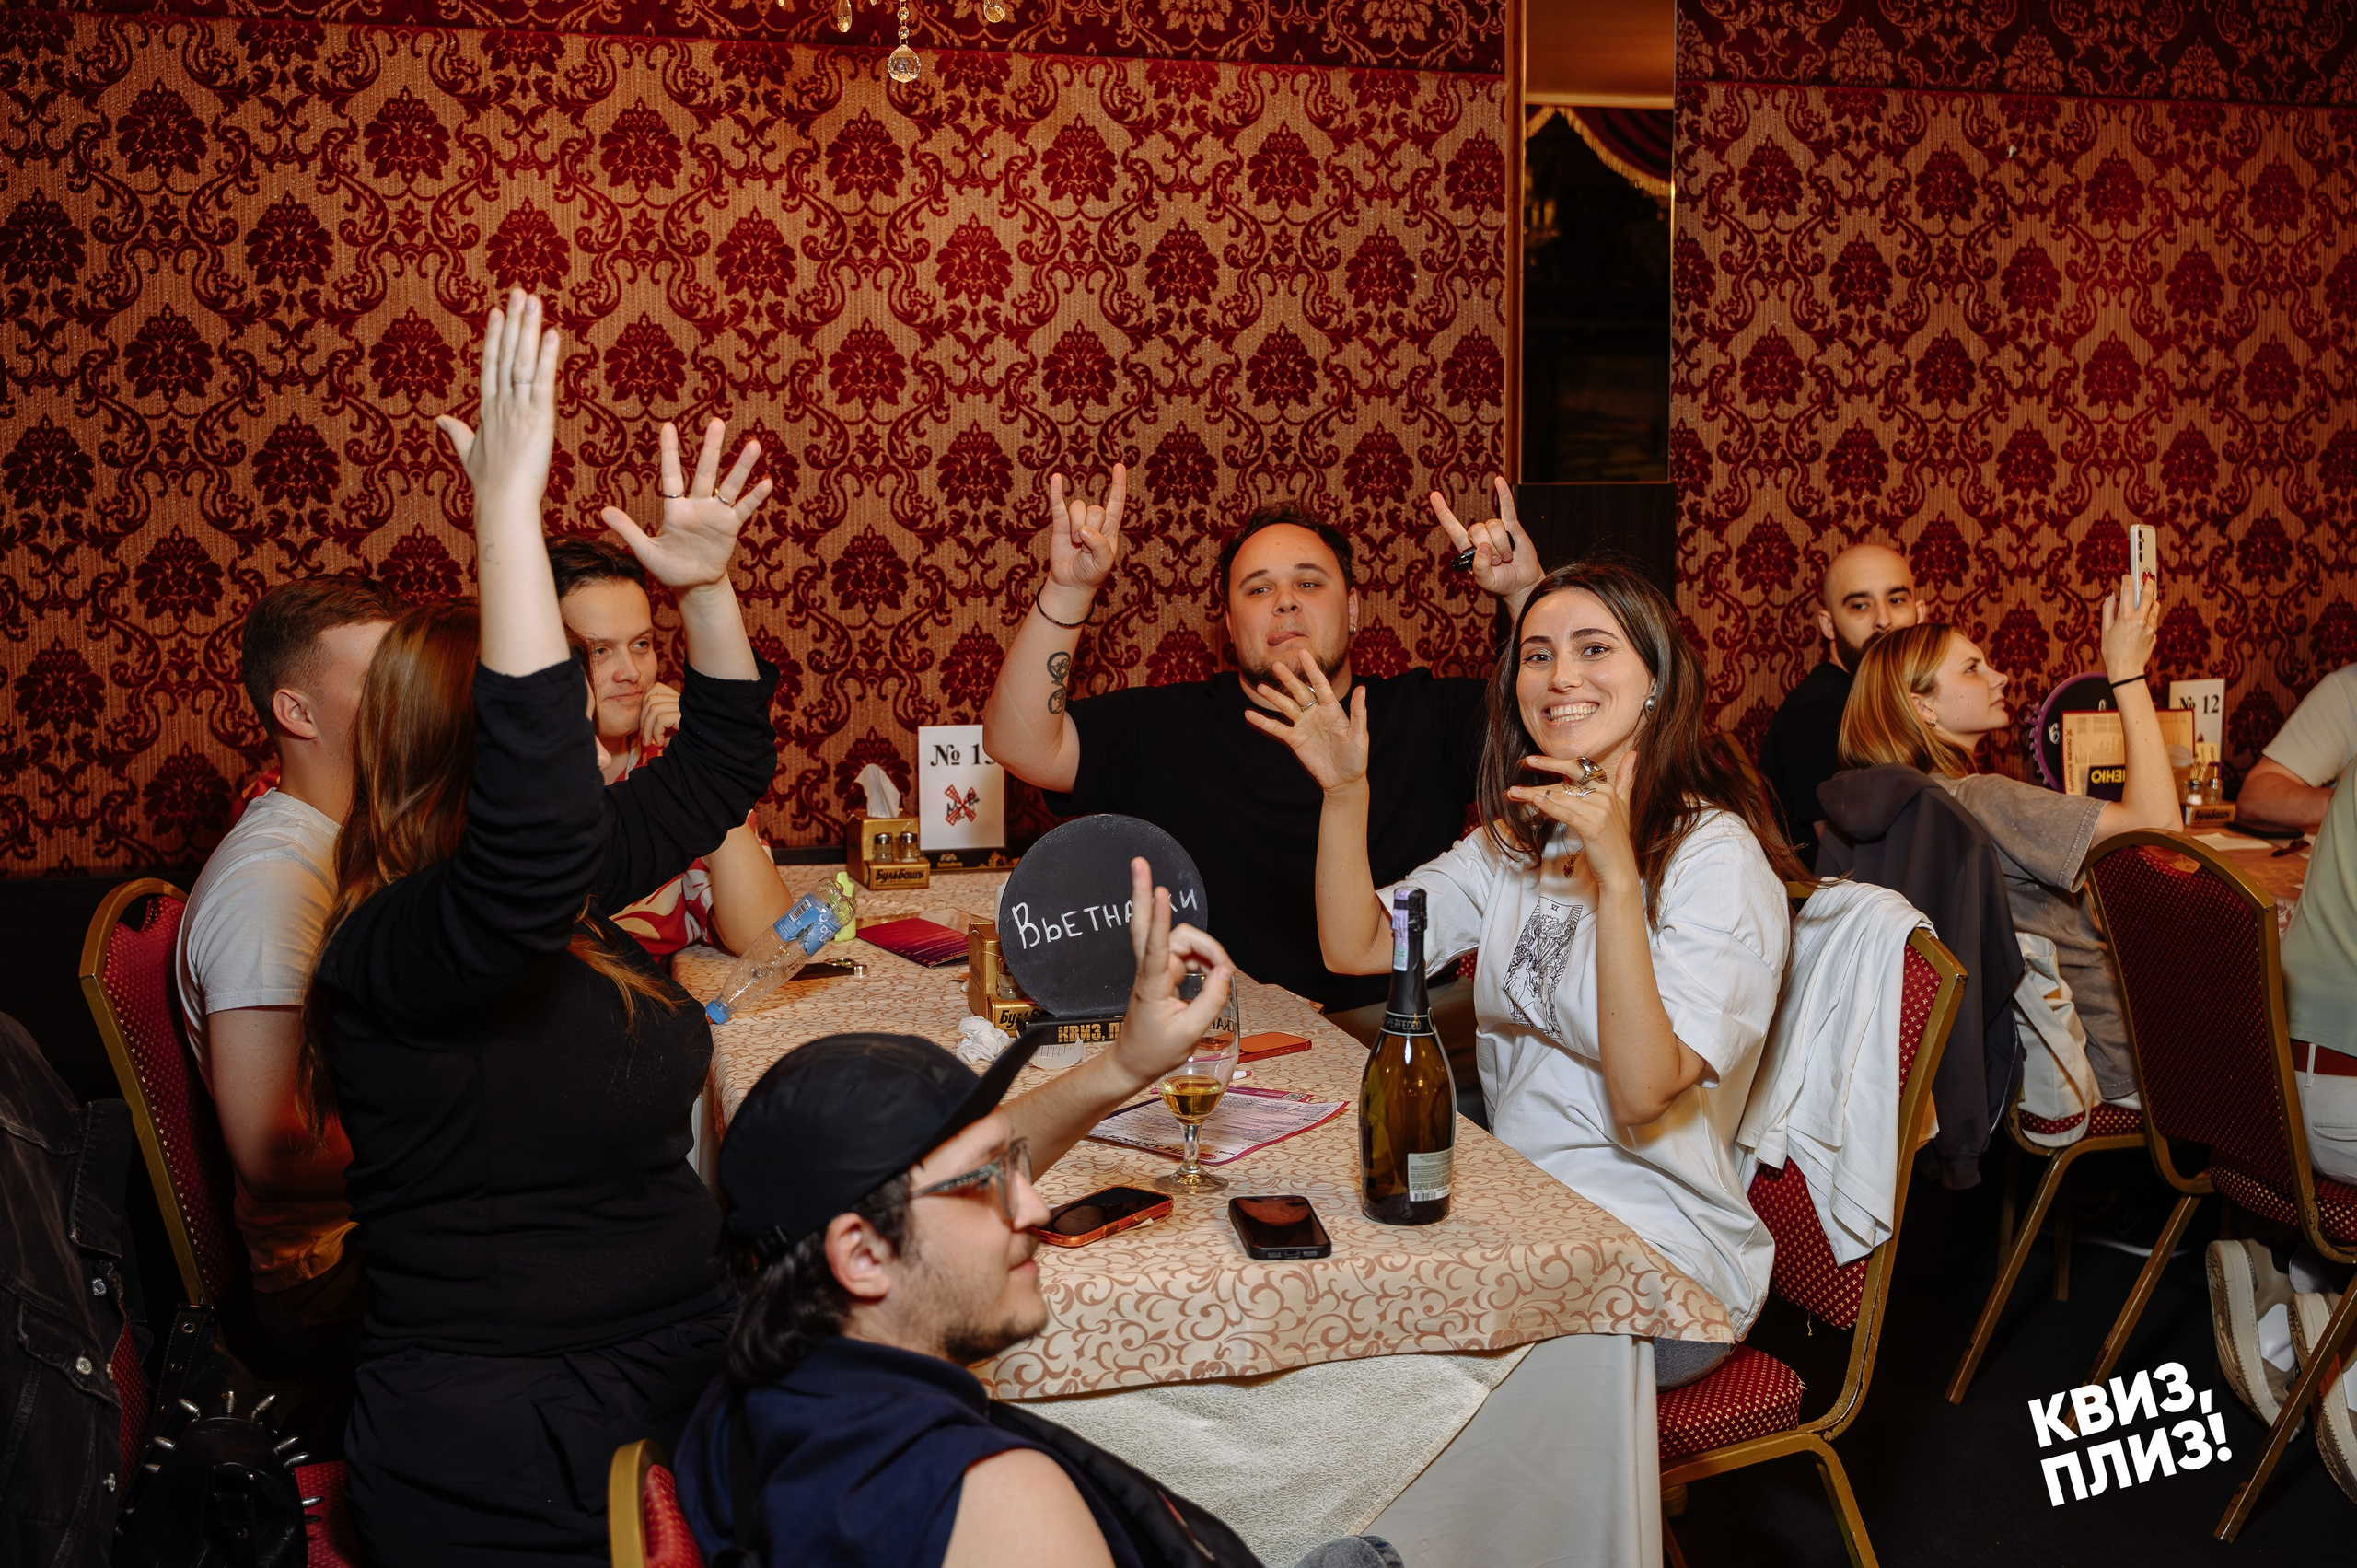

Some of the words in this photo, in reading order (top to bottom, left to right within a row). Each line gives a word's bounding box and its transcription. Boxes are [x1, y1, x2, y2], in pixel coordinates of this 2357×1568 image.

[2203, 693, 2219, 714] 12
[930, 744, 960, 766] №
[2090, 768, 2125, 784] ЕНЮ
[1058, 1023, 1106, 1043] КВИЗ,
